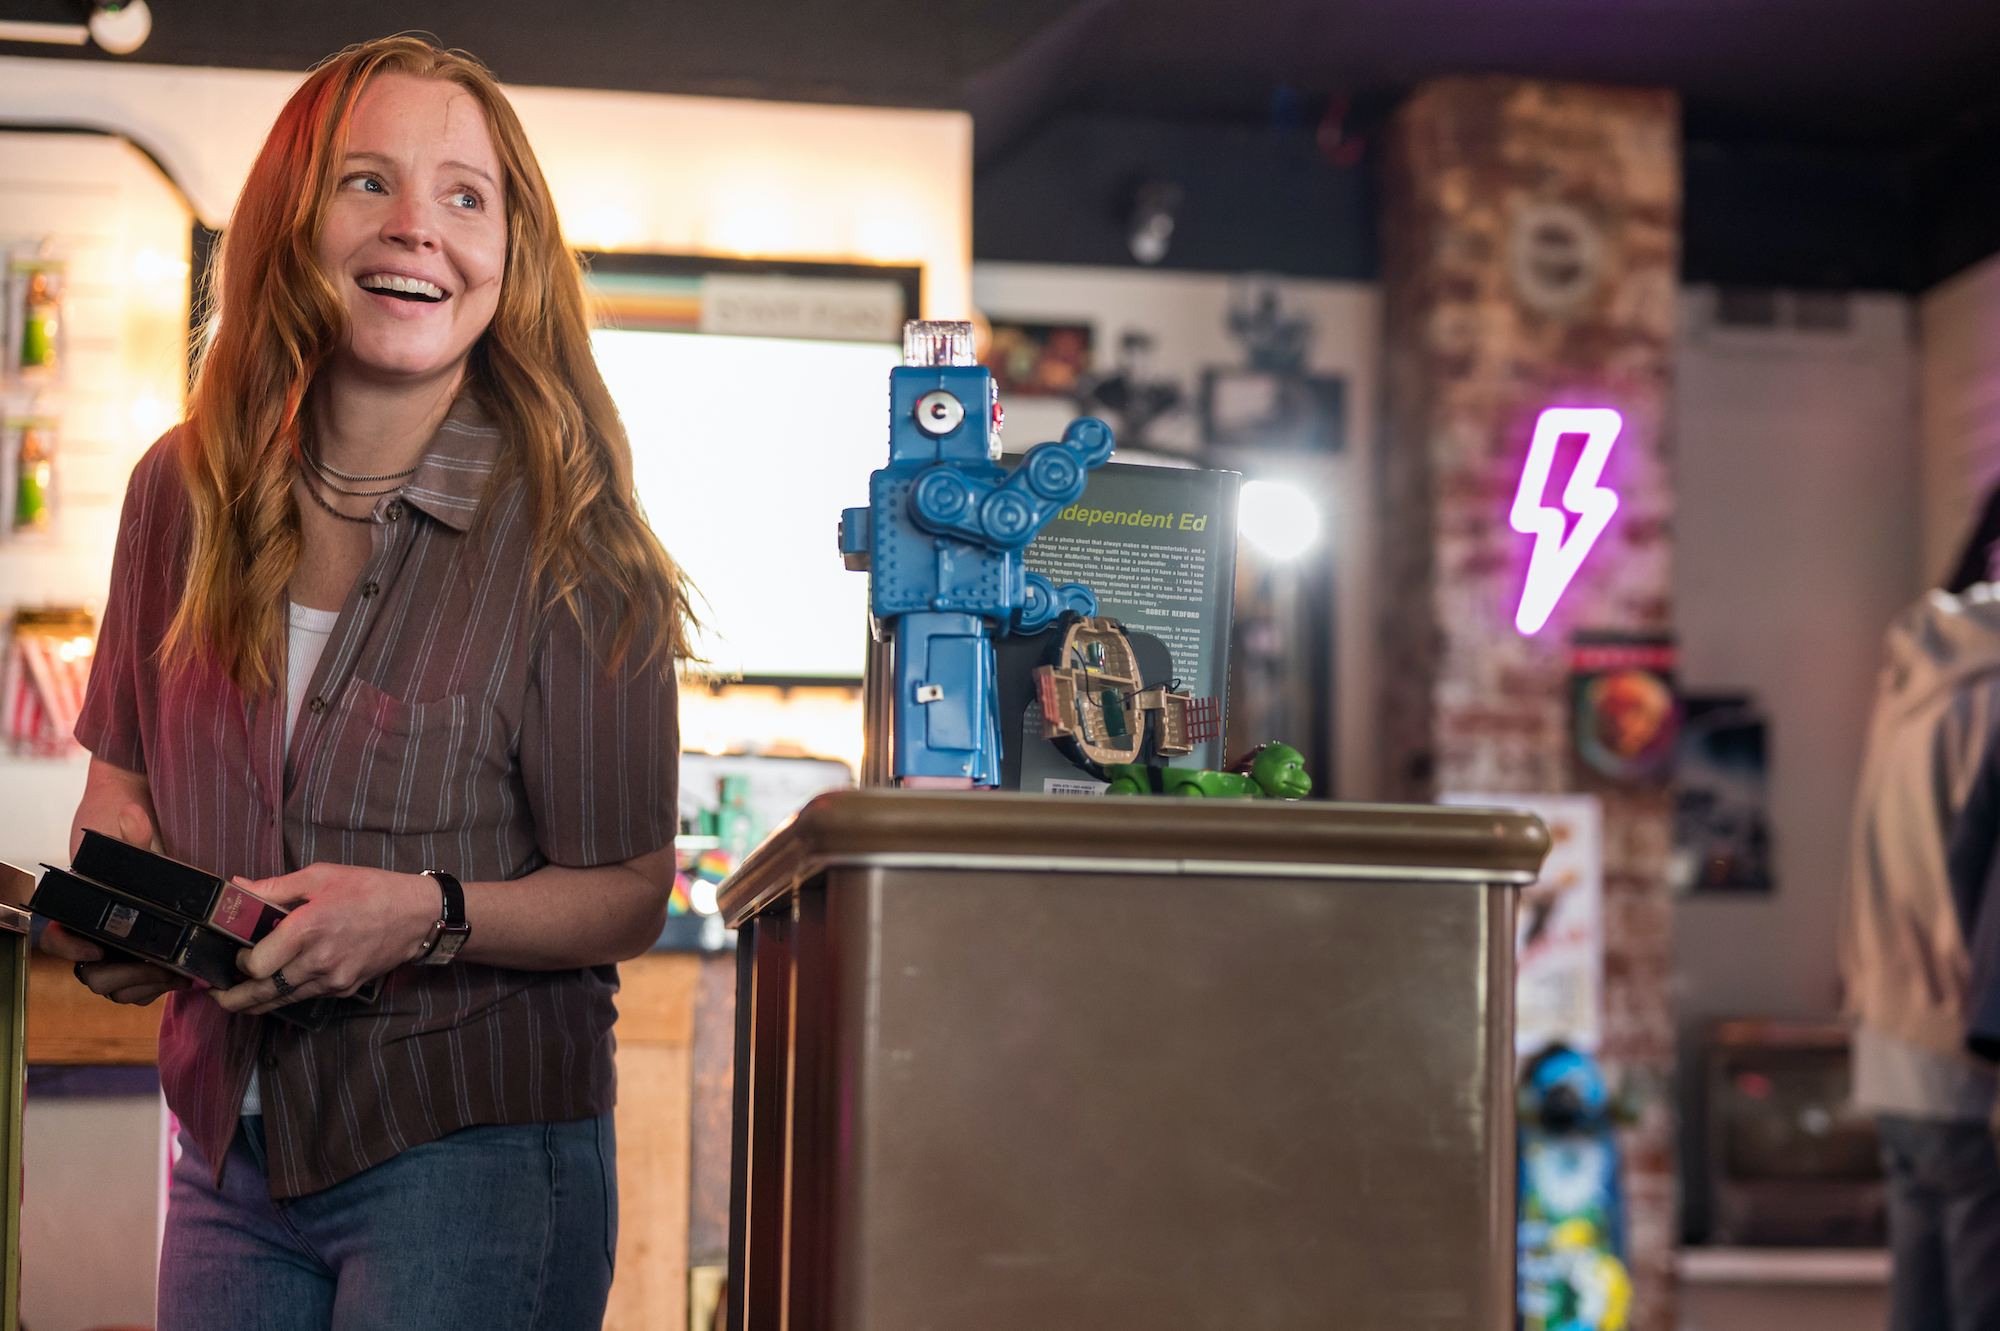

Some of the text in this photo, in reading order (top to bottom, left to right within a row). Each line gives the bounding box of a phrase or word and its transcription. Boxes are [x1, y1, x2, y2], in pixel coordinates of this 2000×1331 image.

[1057, 504, 1207, 531] dependent Ed
[1151, 545, 1189, 554] uncomfortable,
[1096, 572, 1117, 580] heritage
[1172, 610, 1200, 619] REDFORD
